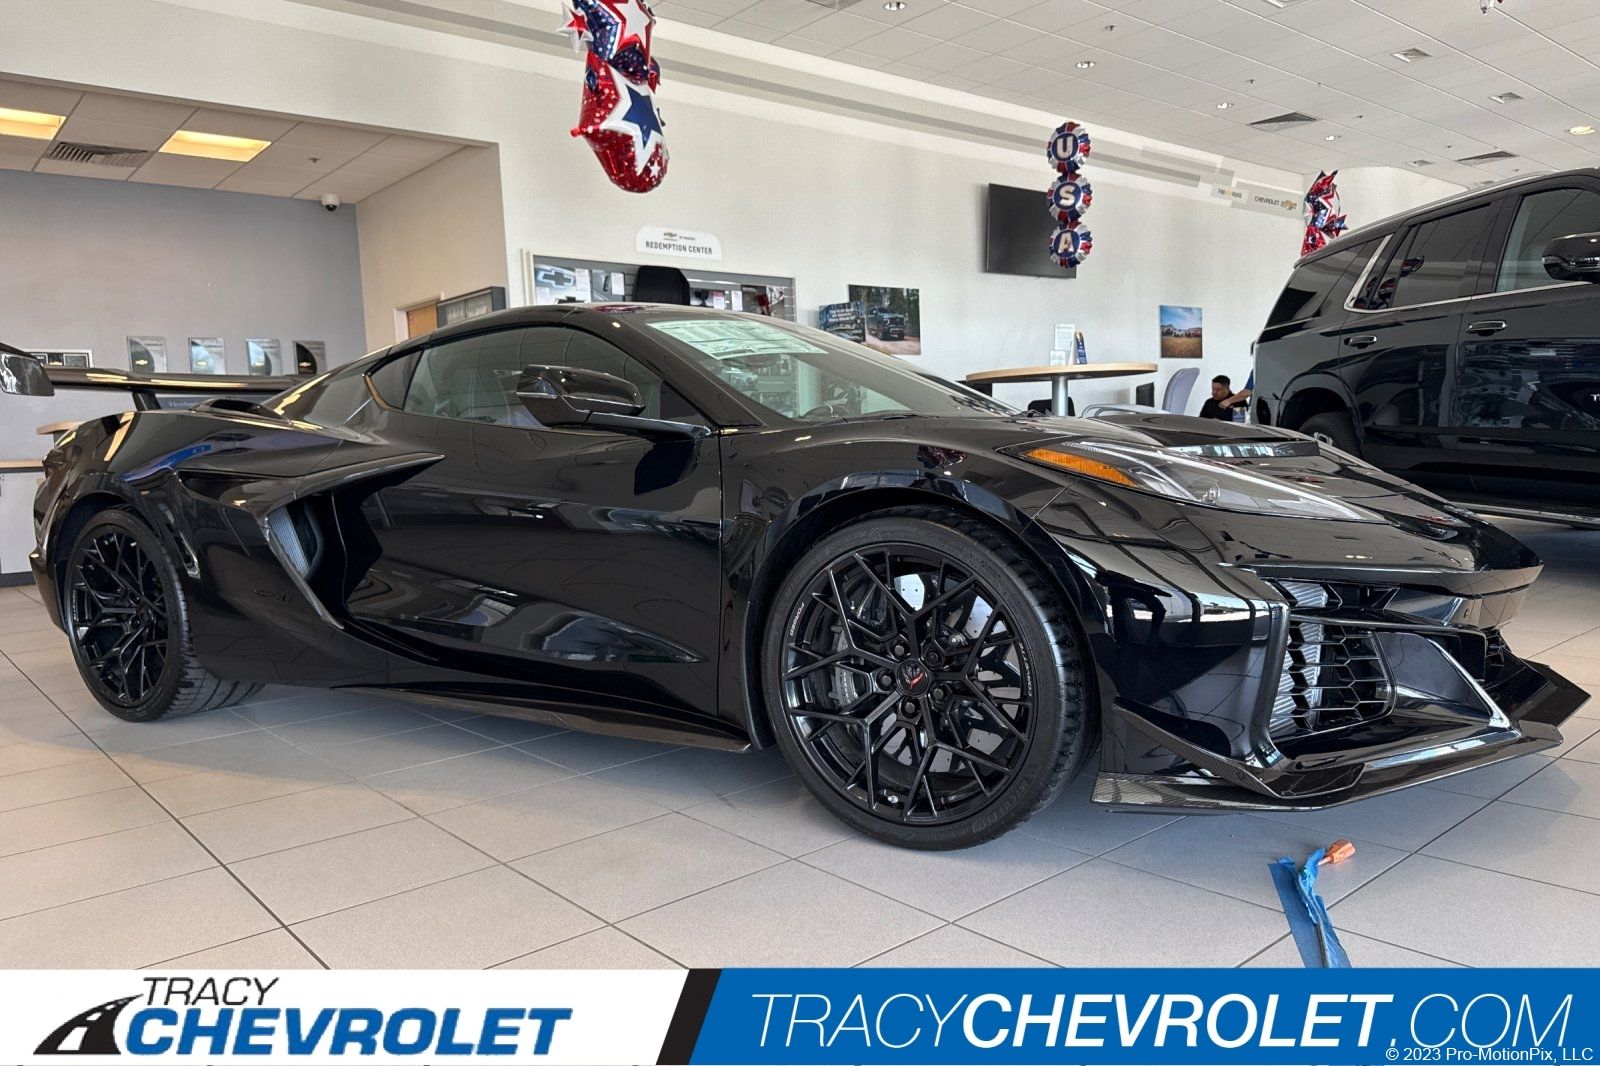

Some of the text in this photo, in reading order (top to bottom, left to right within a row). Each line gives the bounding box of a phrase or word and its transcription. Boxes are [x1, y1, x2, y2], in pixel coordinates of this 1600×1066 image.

[1254, 195, 1281, 206] CHEVROLET
[645, 241, 713, 255] REDEMPTION CENTER
[790, 602, 805, 637] FORGED
